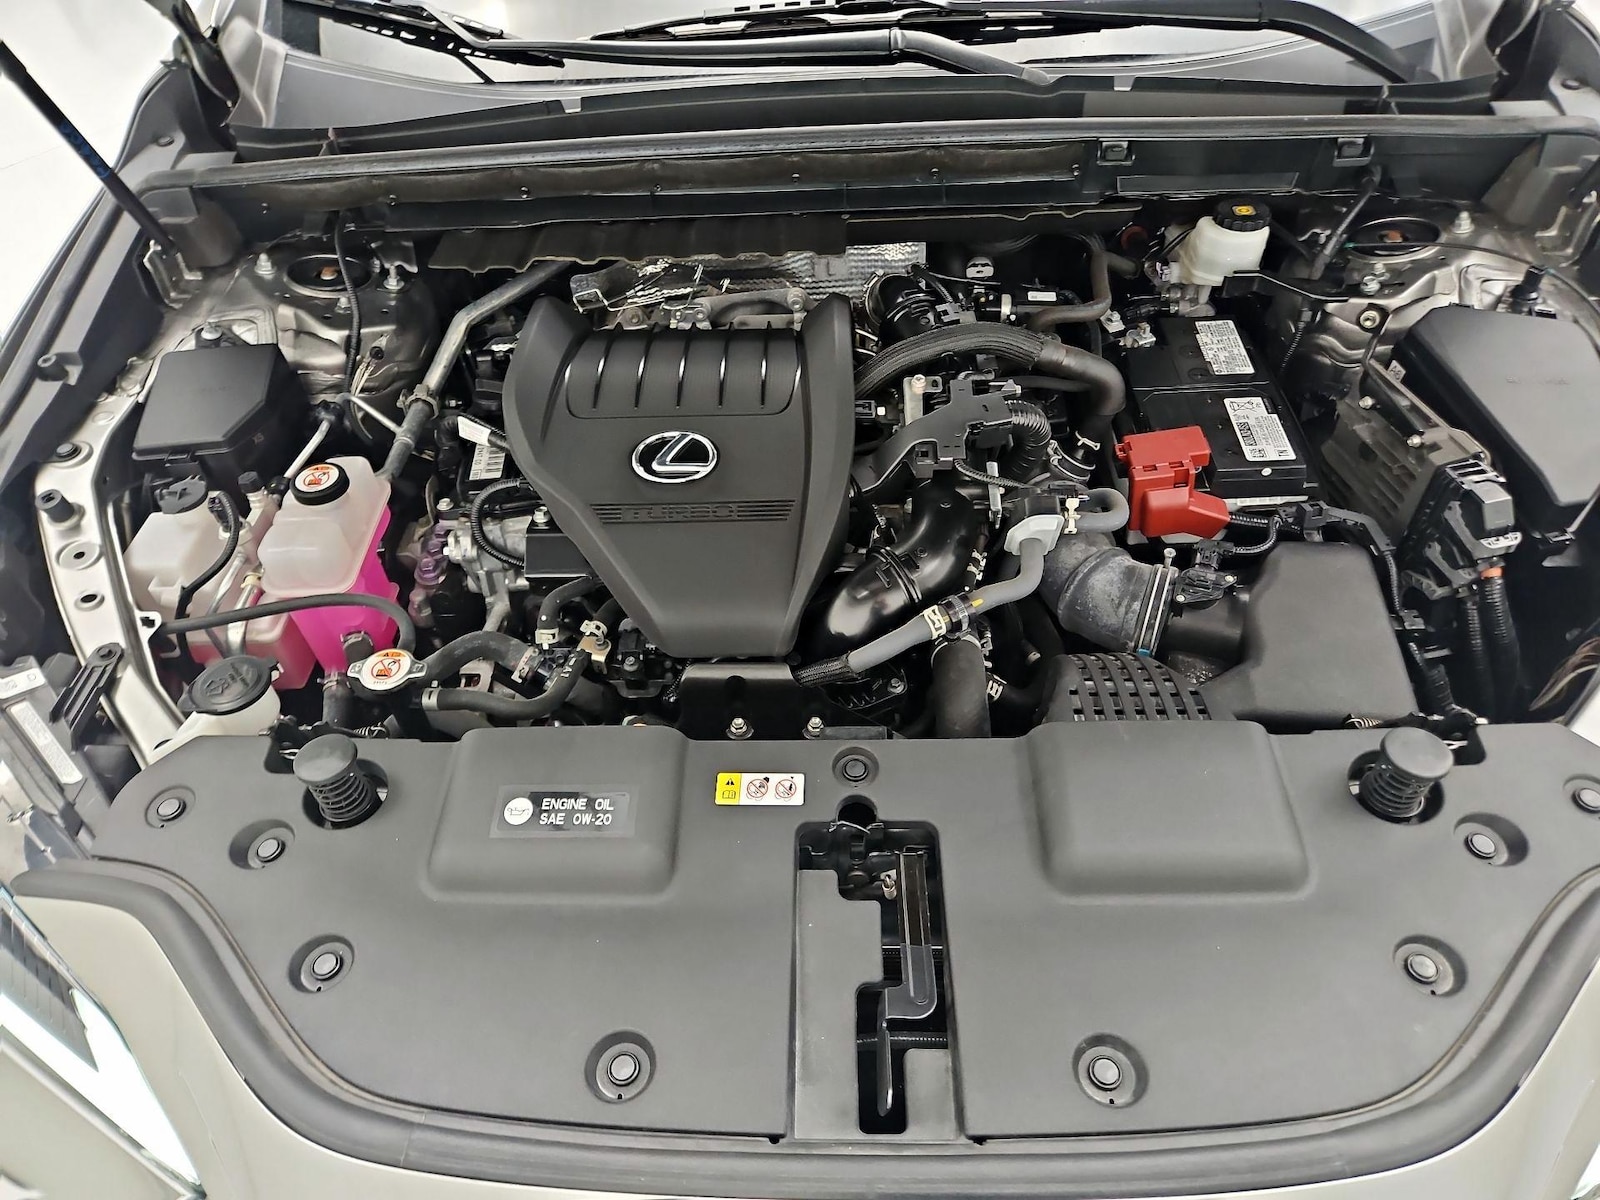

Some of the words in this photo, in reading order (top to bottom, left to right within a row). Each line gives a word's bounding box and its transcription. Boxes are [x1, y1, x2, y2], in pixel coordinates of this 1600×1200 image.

[622, 504, 735, 519] TURBO
[541, 798, 588, 810] ENGINE
[594, 798, 615, 810] OIL
[539, 813, 566, 825] SAE
[572, 813, 613, 826] 0W-20
